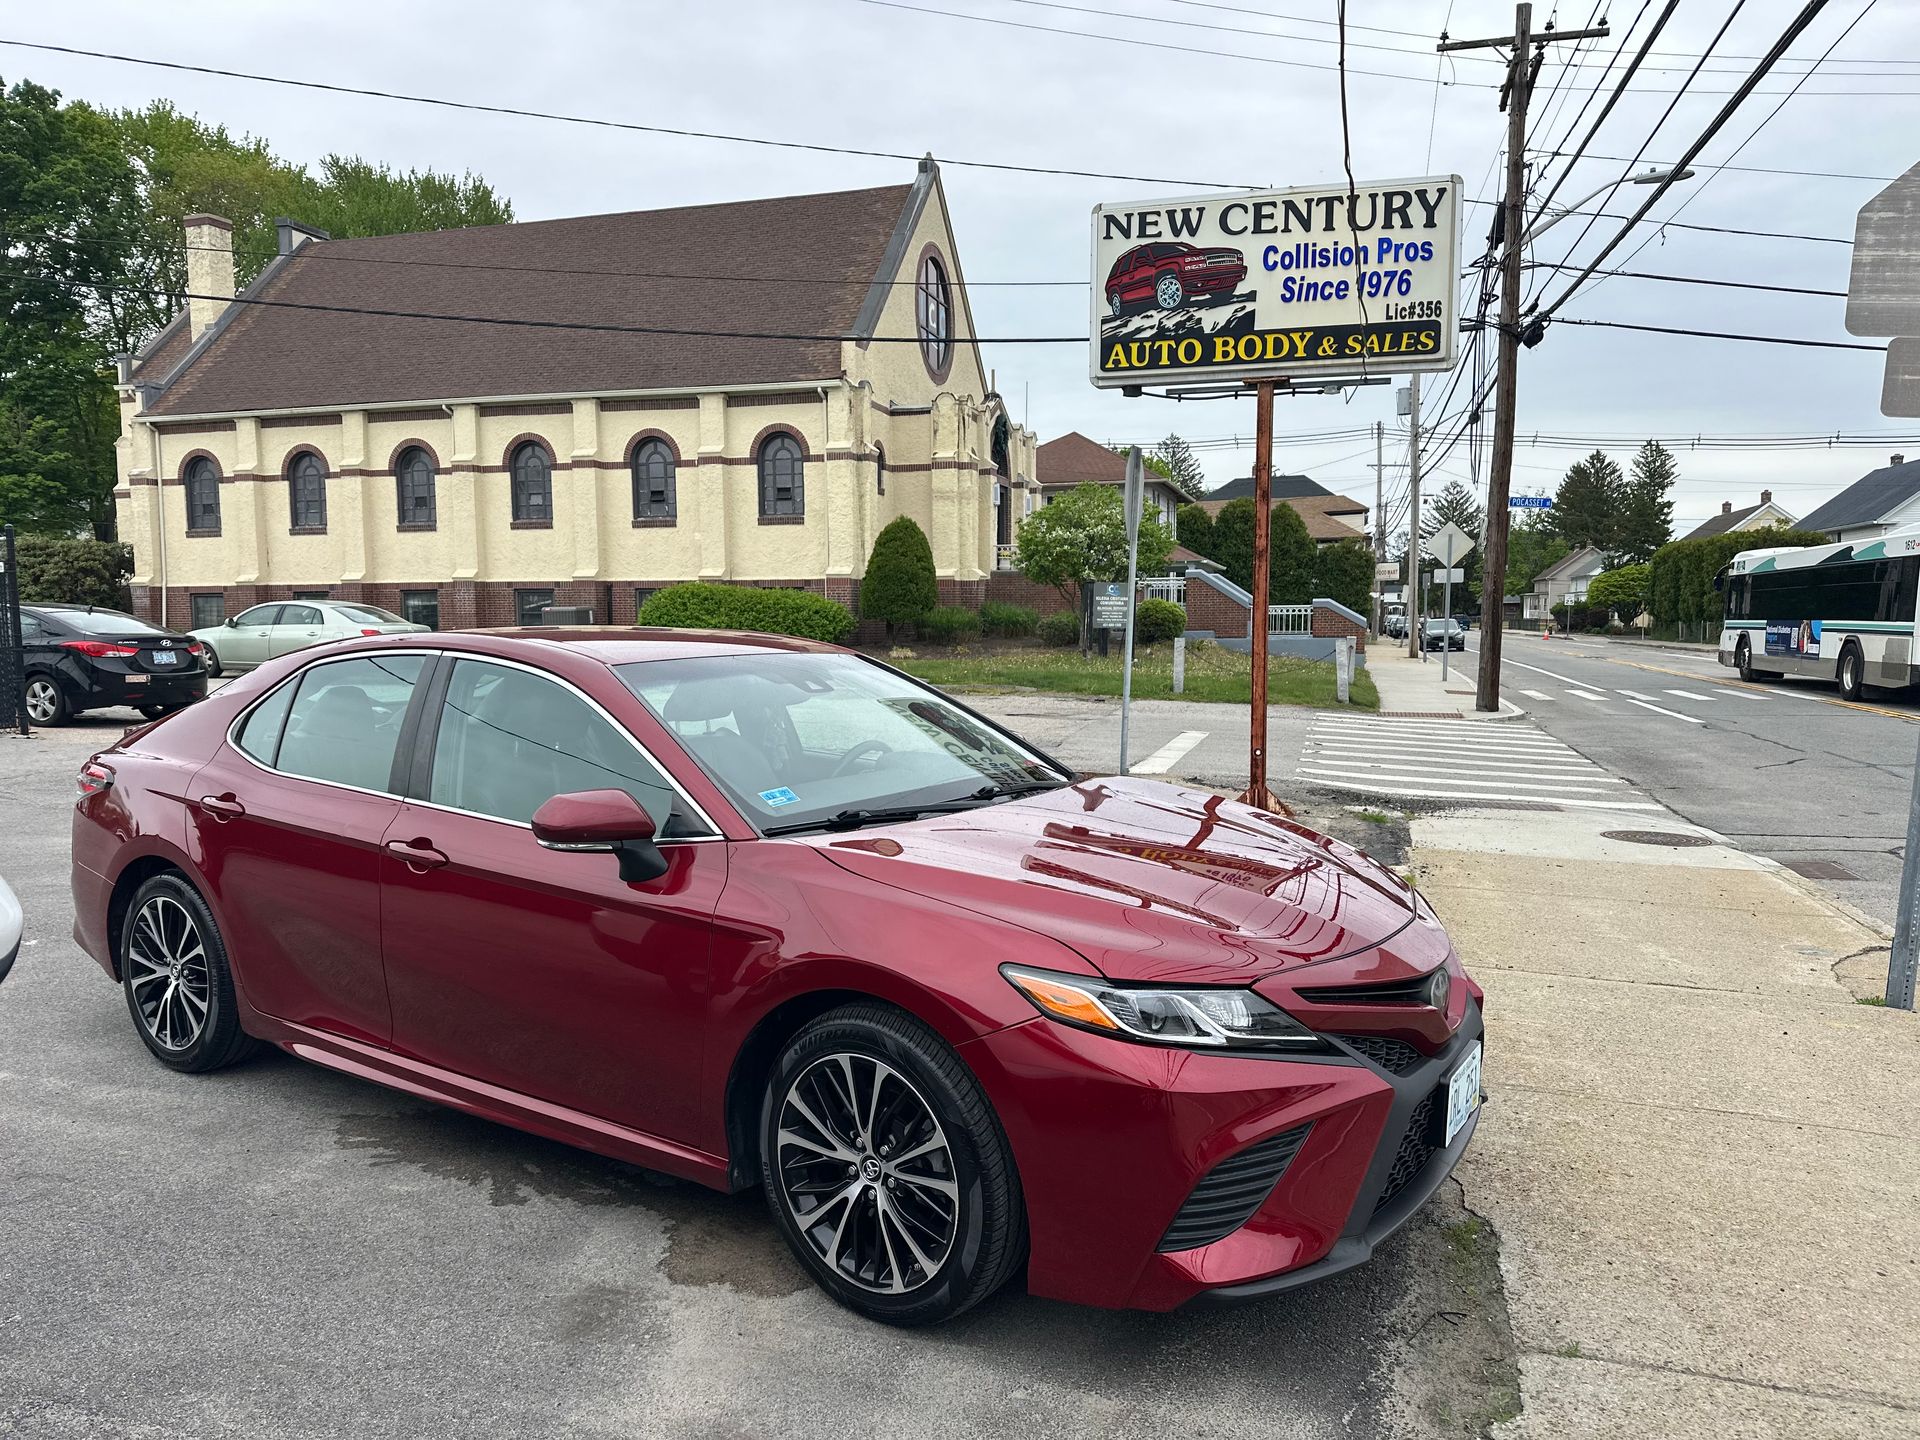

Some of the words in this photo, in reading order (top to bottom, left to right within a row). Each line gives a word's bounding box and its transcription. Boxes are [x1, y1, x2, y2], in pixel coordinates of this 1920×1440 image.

[1102, 206, 1206, 240] NEW
[1218, 187, 1447, 236] CENTURY
[1262, 240, 1369, 272] Collision
[1377, 237, 1434, 264] Pros
[1280, 275, 1349, 303] Since
[1358, 268, 1412, 299] 1976
[1385, 300, 1443, 321] Lic#356
[1104, 336, 1203, 369] AUTO
[1212, 331, 1315, 363] BODY
[1317, 336, 1338, 357] &
[1344, 329, 1436, 356] SALES
[1512, 498, 1544, 507] POCASSET
